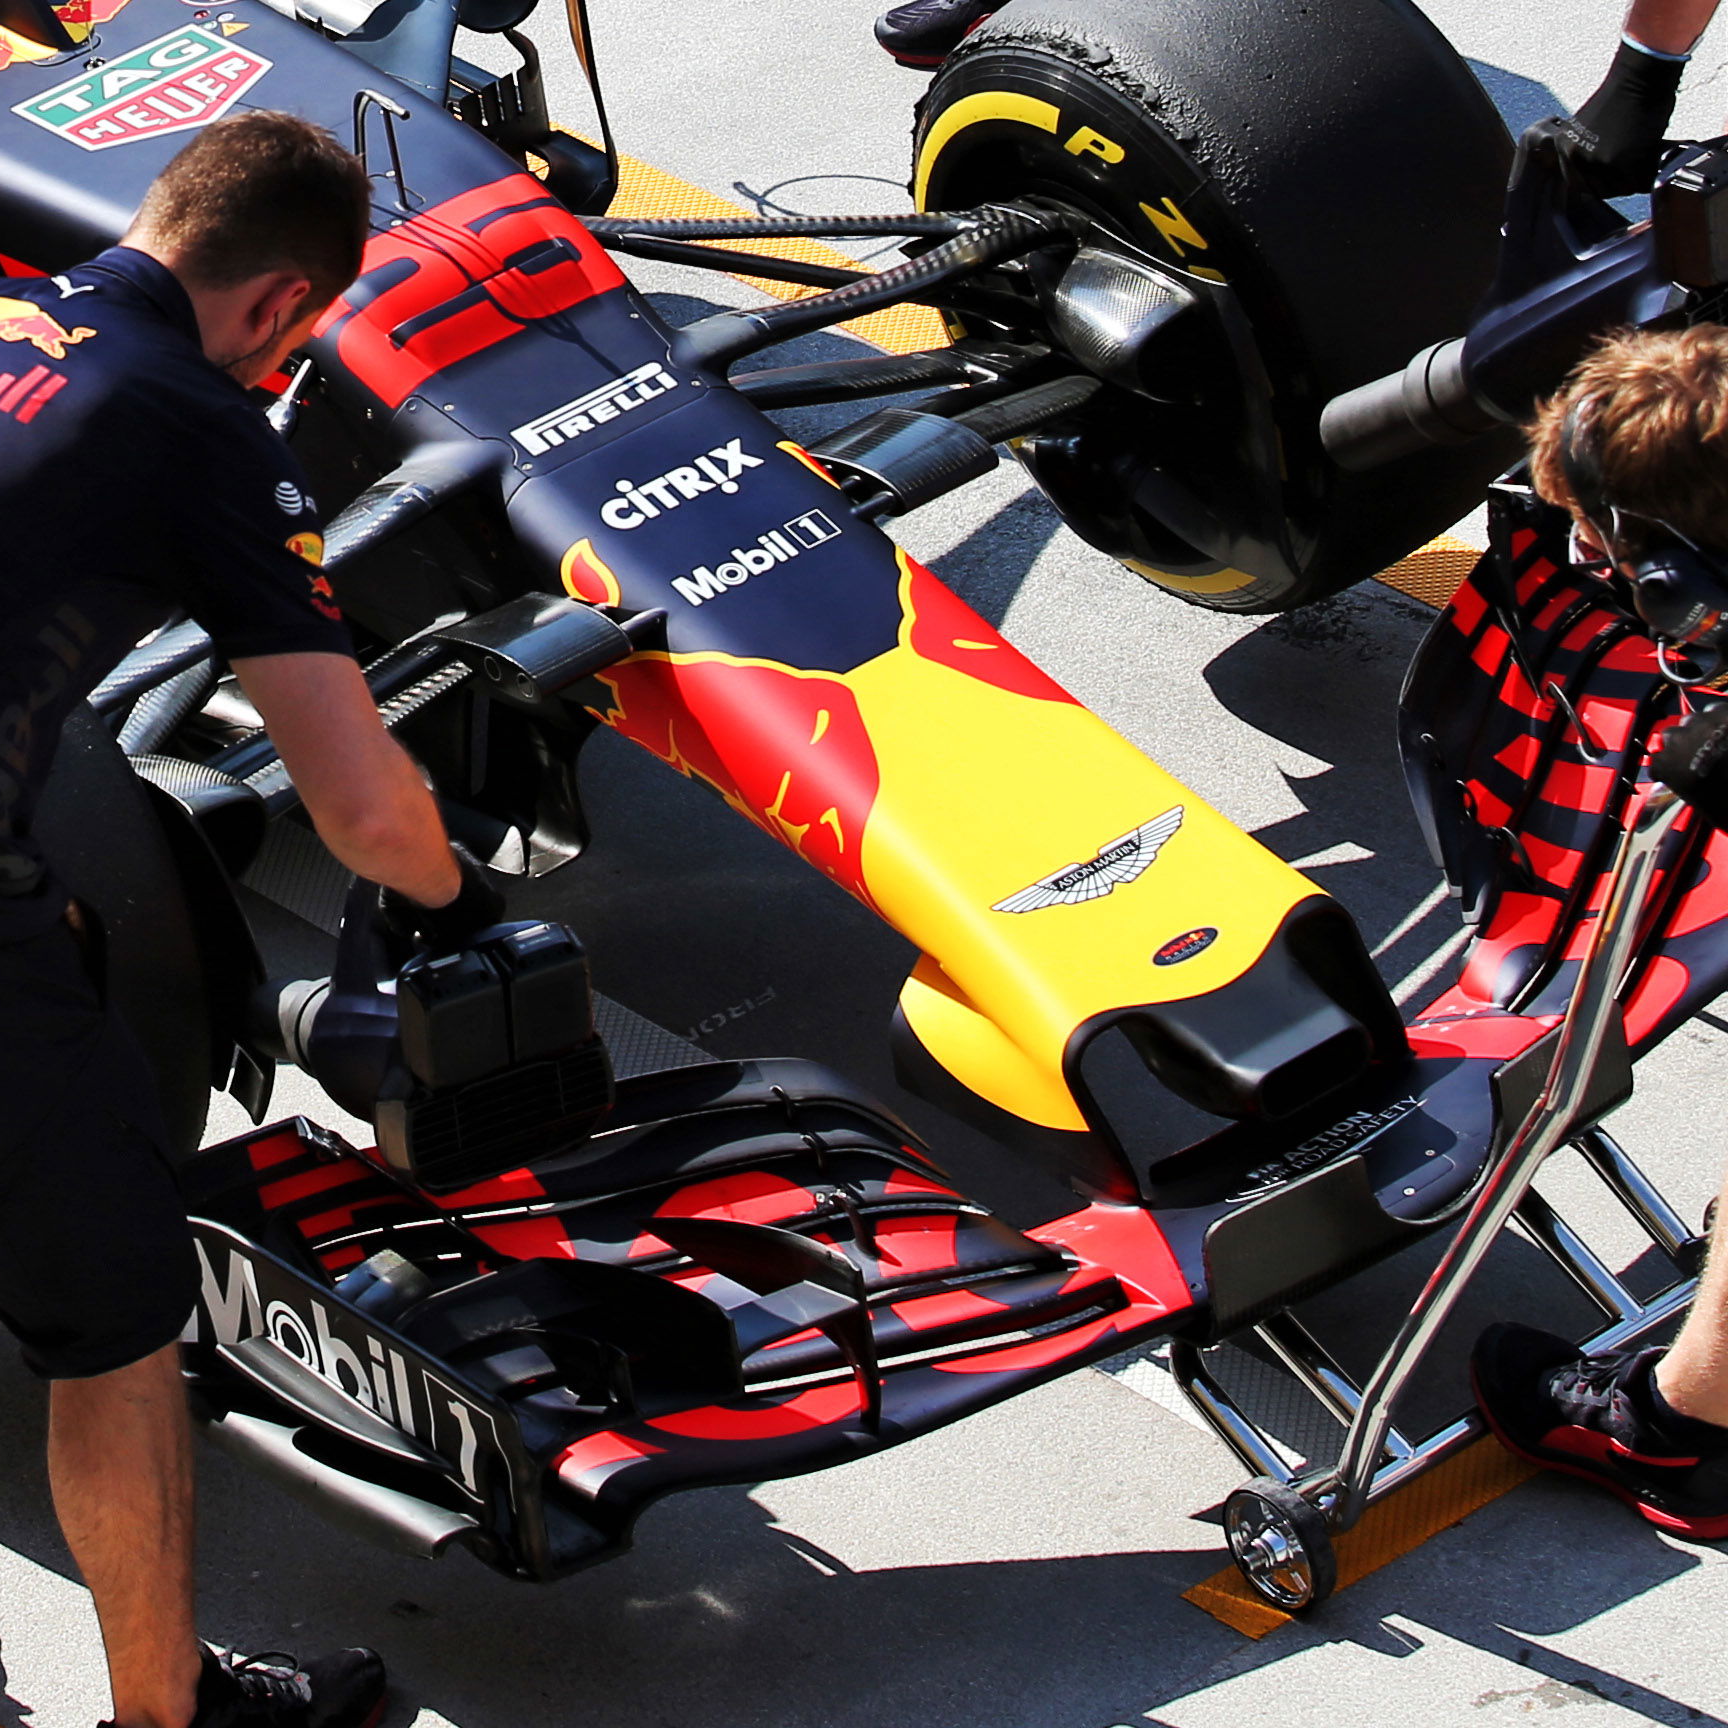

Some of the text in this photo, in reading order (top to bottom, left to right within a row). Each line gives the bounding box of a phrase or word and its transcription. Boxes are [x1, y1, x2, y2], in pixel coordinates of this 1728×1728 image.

[38, 31, 214, 113] TAG
[78, 55, 256, 141] HEUER
[1065, 124, 1126, 165] P
[509, 361, 679, 458] PIRELLI
[600, 437, 766, 533] CITRIX
[670, 528, 800, 608] Mobil
[1057, 841, 1137, 890] ASTON MARTIN
[1283, 1110, 1374, 1162] ACTION
[1292, 1138, 1348, 1170] ROAD
[1345, 1094, 1419, 1140] SAFETY
[179, 1236, 417, 1438] Mobil
